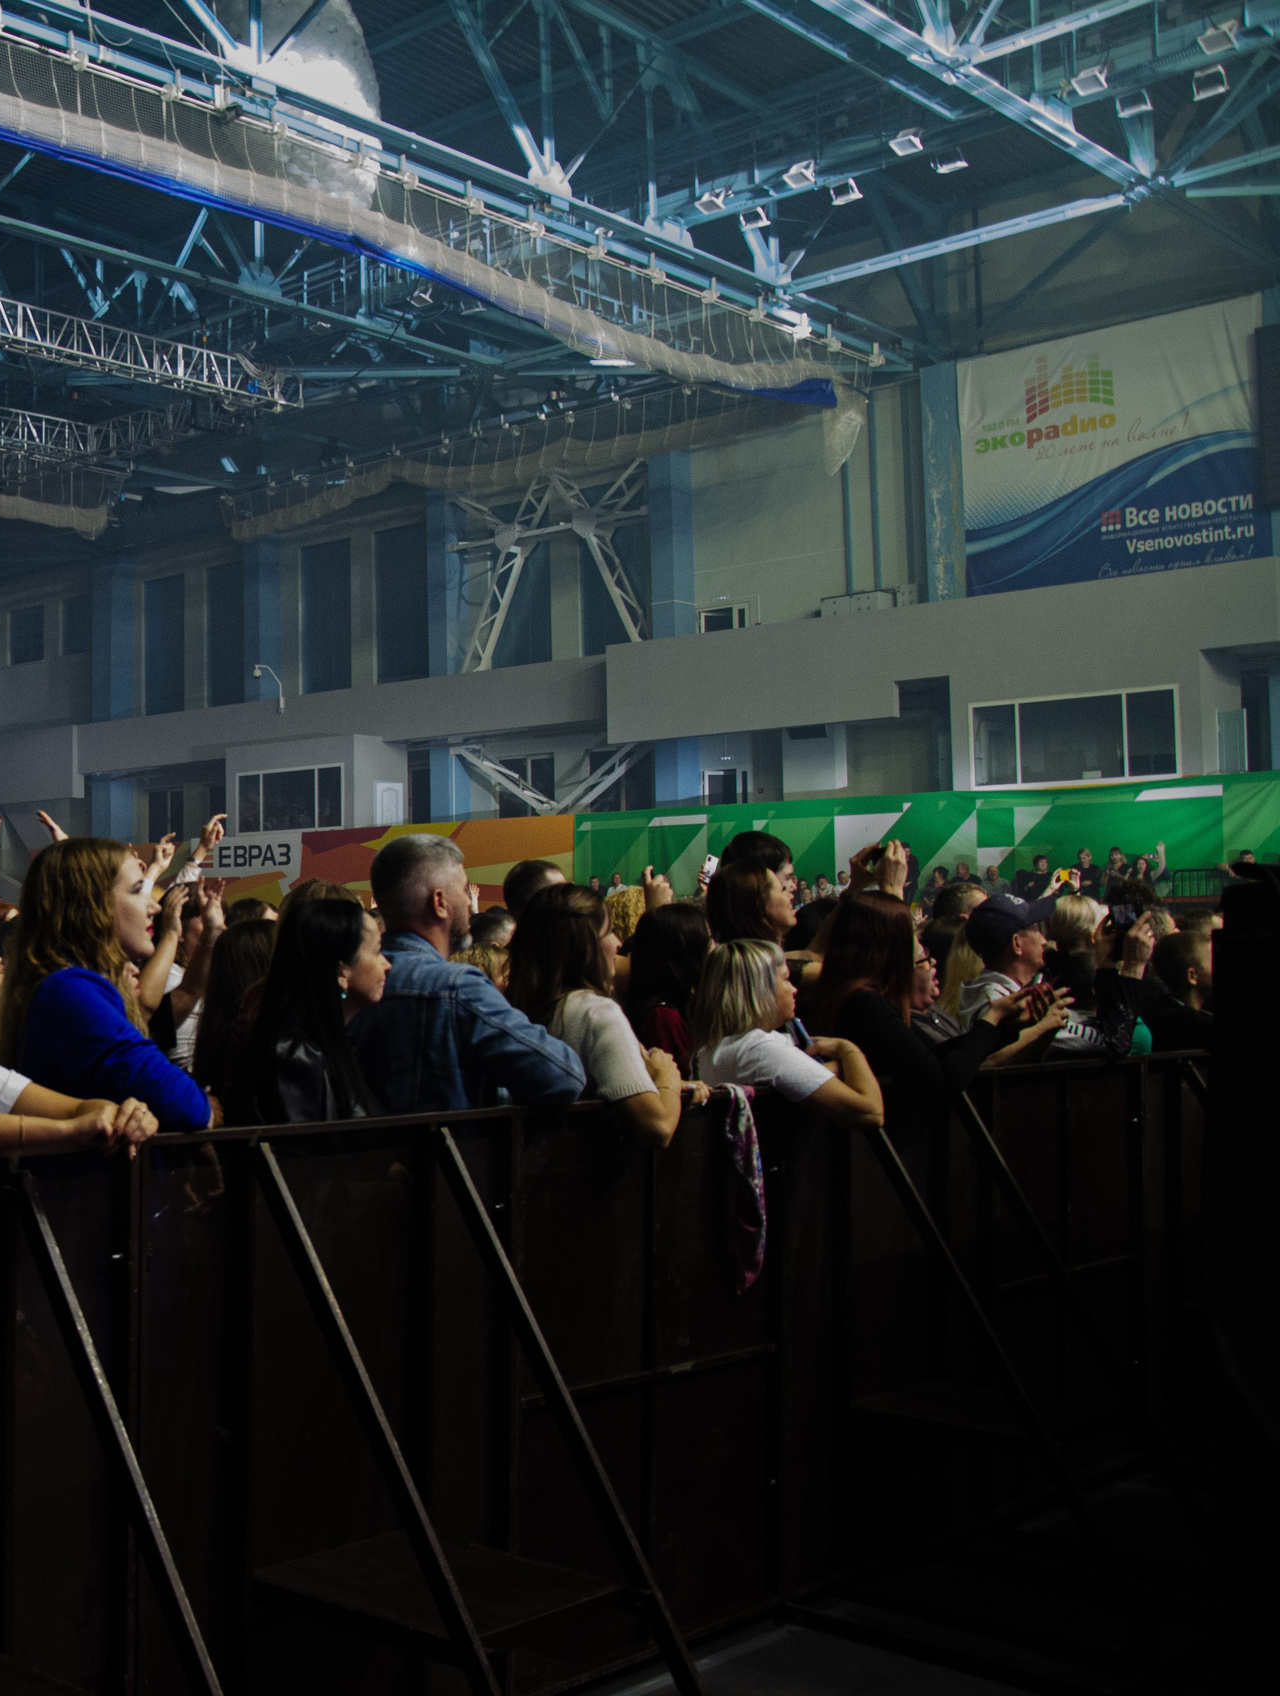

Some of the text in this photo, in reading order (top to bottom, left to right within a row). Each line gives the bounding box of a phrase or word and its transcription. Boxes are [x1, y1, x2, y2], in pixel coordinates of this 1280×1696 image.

[1124, 507, 1160, 528] Все
[1126, 523, 1255, 554] Vsenovostint.ru
[218, 843, 291, 868] ЕВРАЗ
